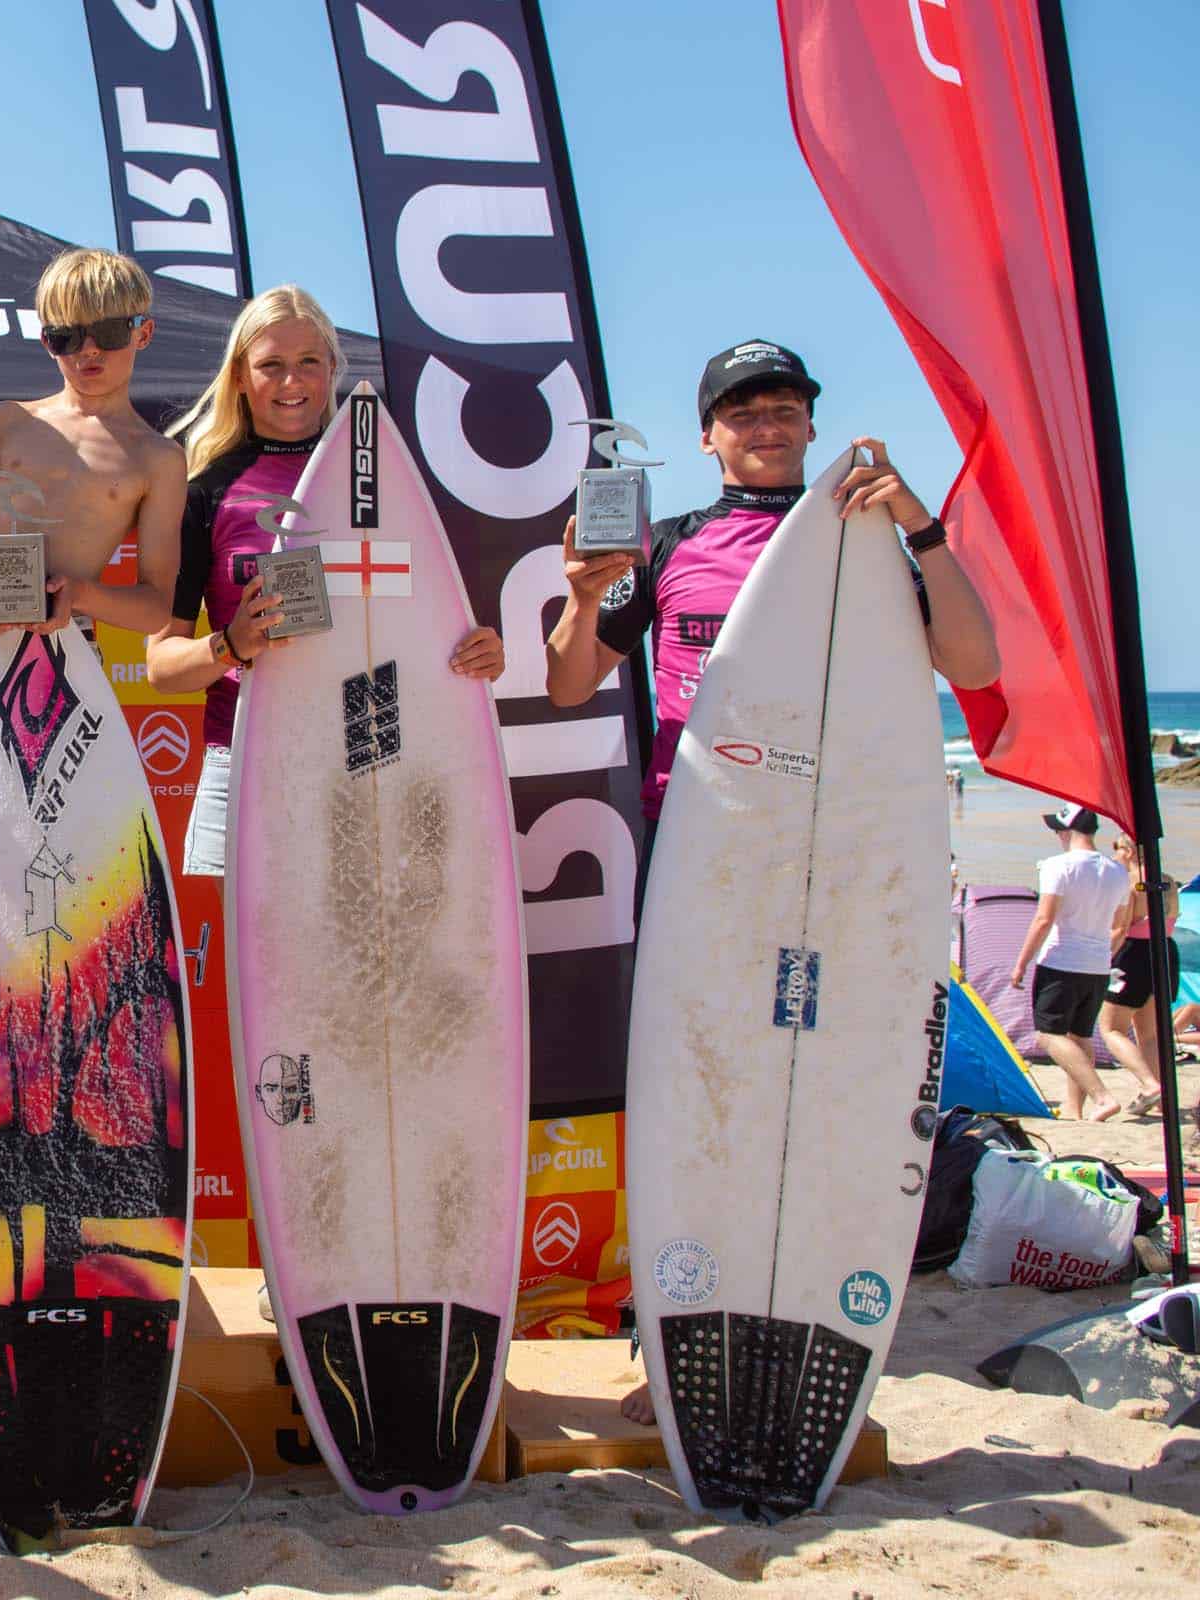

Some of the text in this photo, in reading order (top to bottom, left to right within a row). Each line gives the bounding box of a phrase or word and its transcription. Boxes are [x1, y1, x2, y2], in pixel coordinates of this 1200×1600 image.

[34, 708, 104, 824] RIP CURL
[917, 980, 950, 1103] Bradley
[552, 1147, 608, 1172] CURL
[1016, 1237, 1110, 1280] the food
[27, 1308, 87, 1324] FCS
[371, 1311, 429, 1325] FCS
